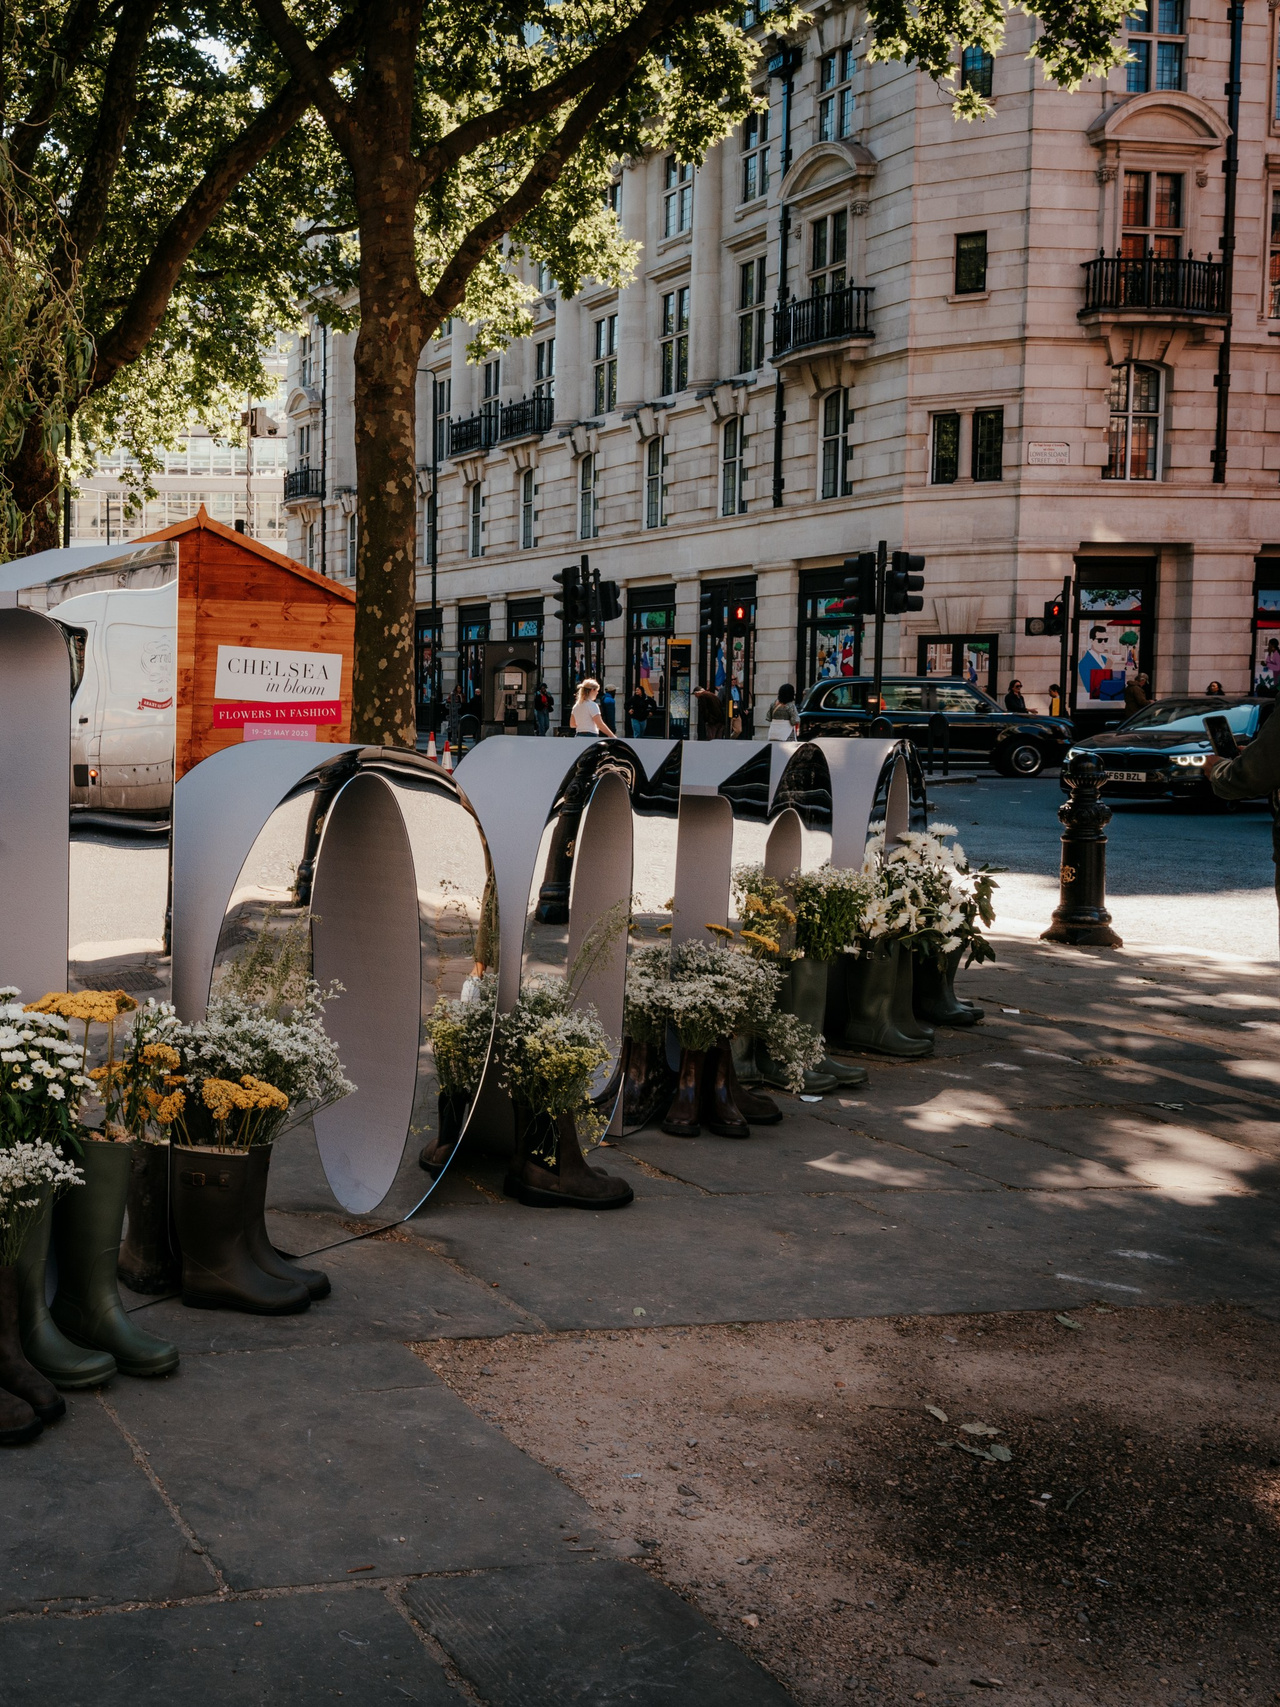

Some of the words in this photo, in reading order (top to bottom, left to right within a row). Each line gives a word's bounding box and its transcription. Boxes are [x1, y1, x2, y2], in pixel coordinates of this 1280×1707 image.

[227, 657, 330, 680] CHELSEA
[266, 677, 280, 693] in
[283, 678, 326, 696] bloom
[219, 709, 272, 720] FLOWERS
[275, 709, 286, 718] IN
[290, 707, 337, 717] FASHION
[291, 729, 309, 737] 2025
